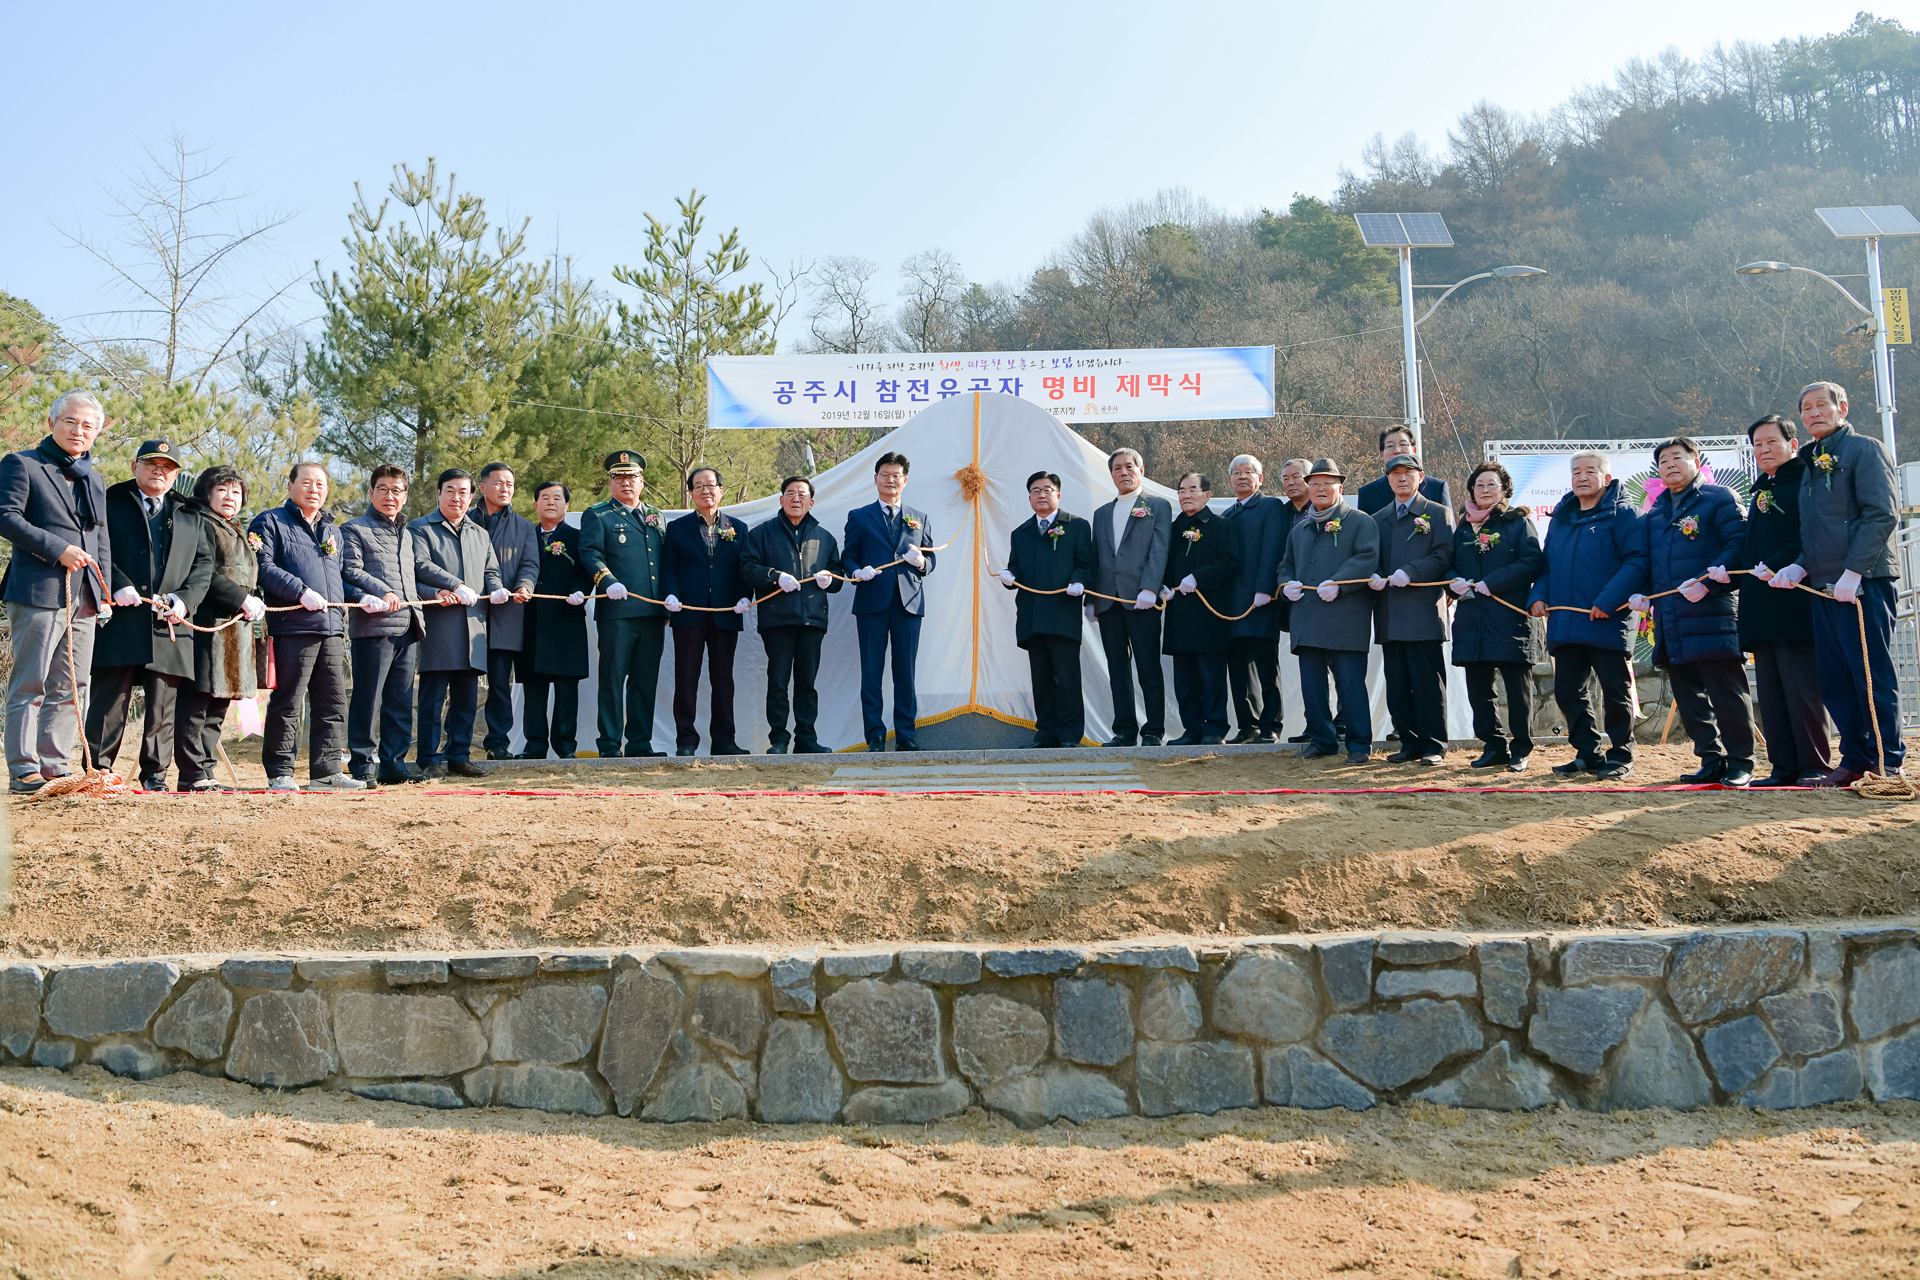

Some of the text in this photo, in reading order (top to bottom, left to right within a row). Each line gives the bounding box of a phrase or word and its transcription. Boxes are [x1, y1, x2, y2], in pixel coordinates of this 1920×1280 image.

[856, 361, 883, 373] 나라를
[886, 362, 905, 372] 위한
[908, 361, 935, 372] 고귀한
[967, 358, 1002, 371] 따뜻한
[1007, 357, 1046, 371] 보훈으로
[1051, 356, 1073, 369] 보답
[1076, 357, 1122, 368] 하겠습니다
[772, 380, 856, 405] 공주시
[1042, 375, 1096, 400] 명비
[1115, 372, 1201, 398] 제막식
[821, 411, 850, 421] 2019년
[853, 410, 871, 421] 12월
[873, 409, 906, 420] 16일(월)
